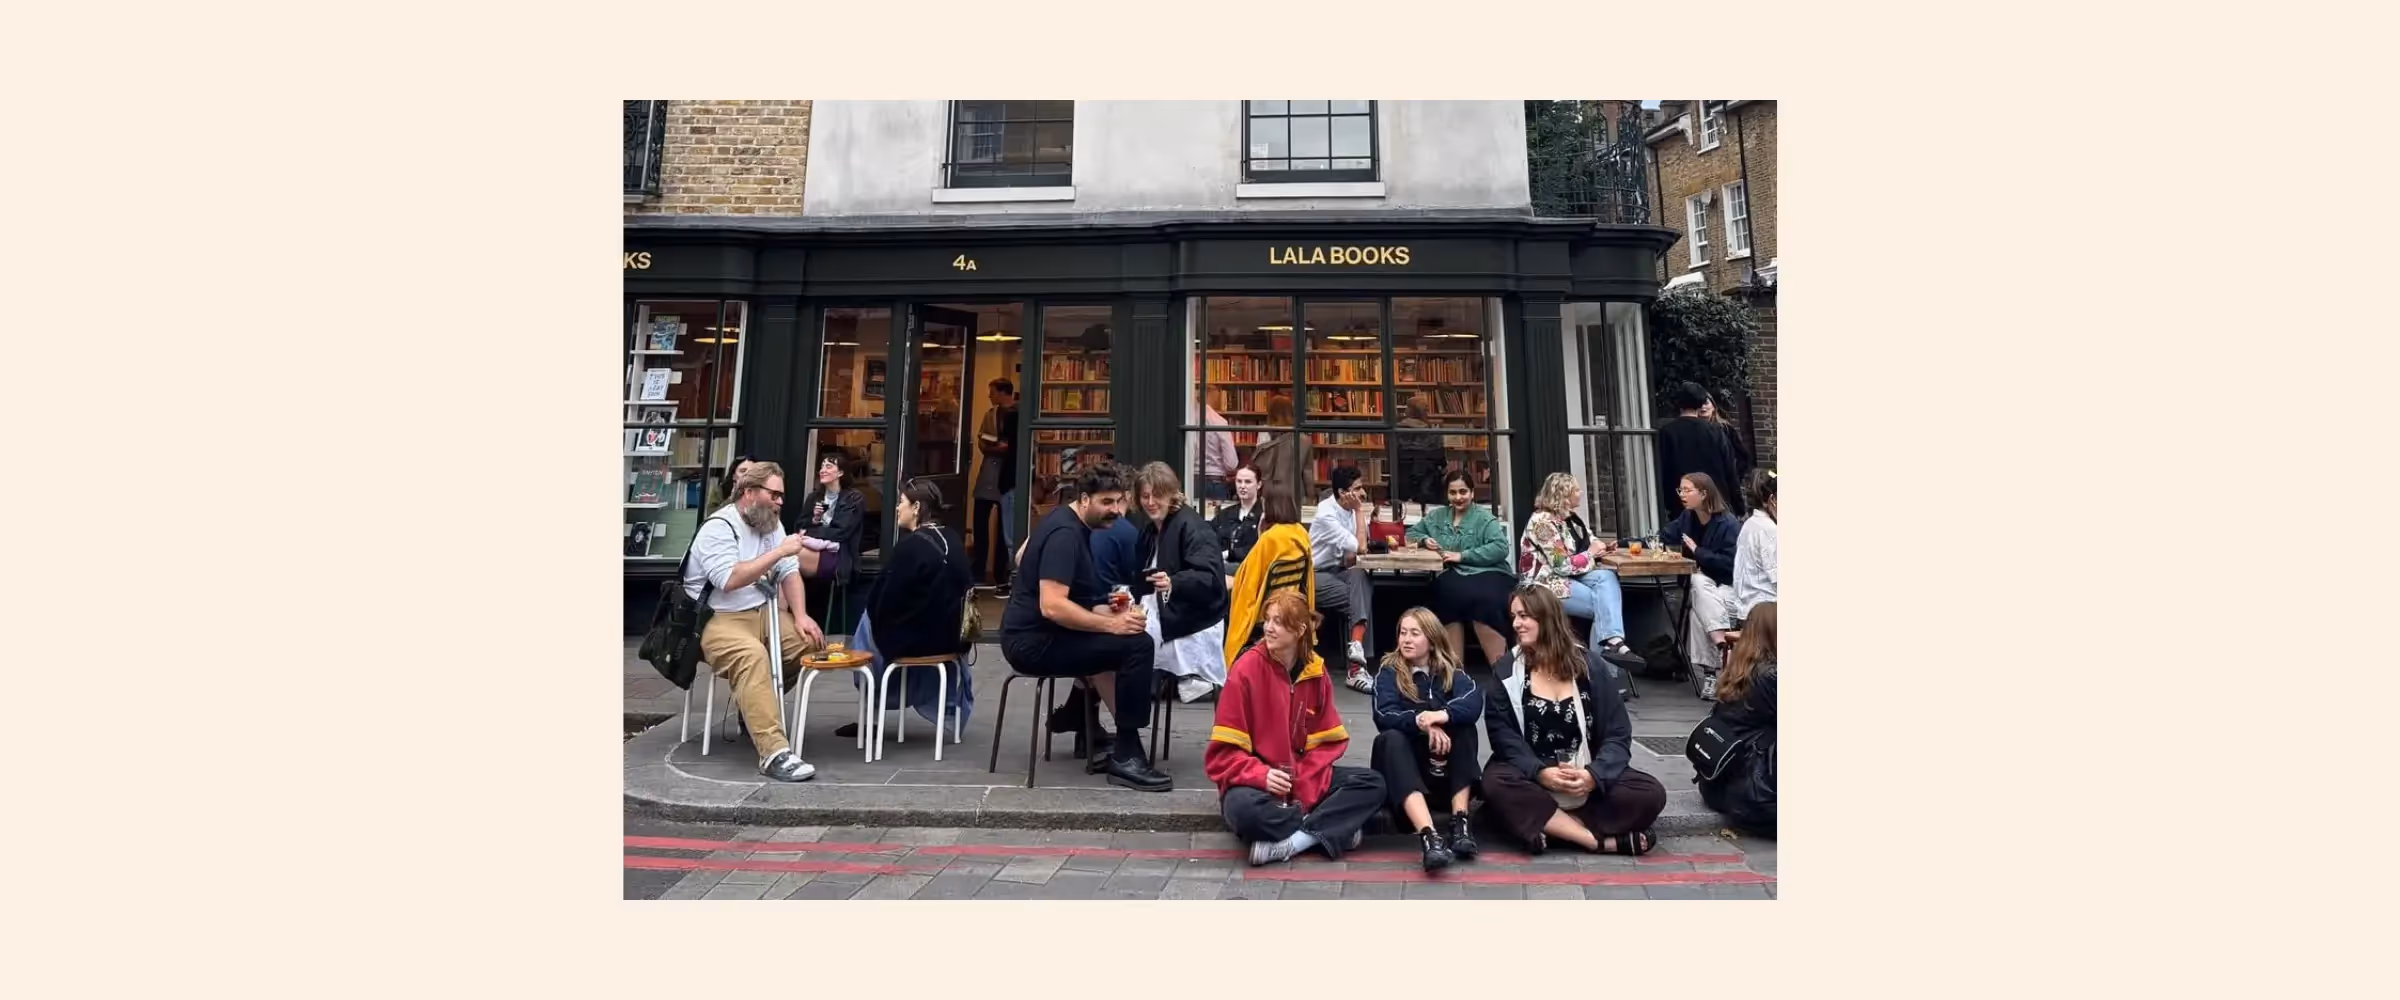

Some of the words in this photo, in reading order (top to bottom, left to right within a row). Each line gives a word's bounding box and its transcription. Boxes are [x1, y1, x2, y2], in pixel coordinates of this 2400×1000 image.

[623, 251, 652, 269] KS
[952, 254, 977, 270] 4A
[1270, 246, 1326, 265] LALA
[1330, 246, 1410, 265] BOOKS
